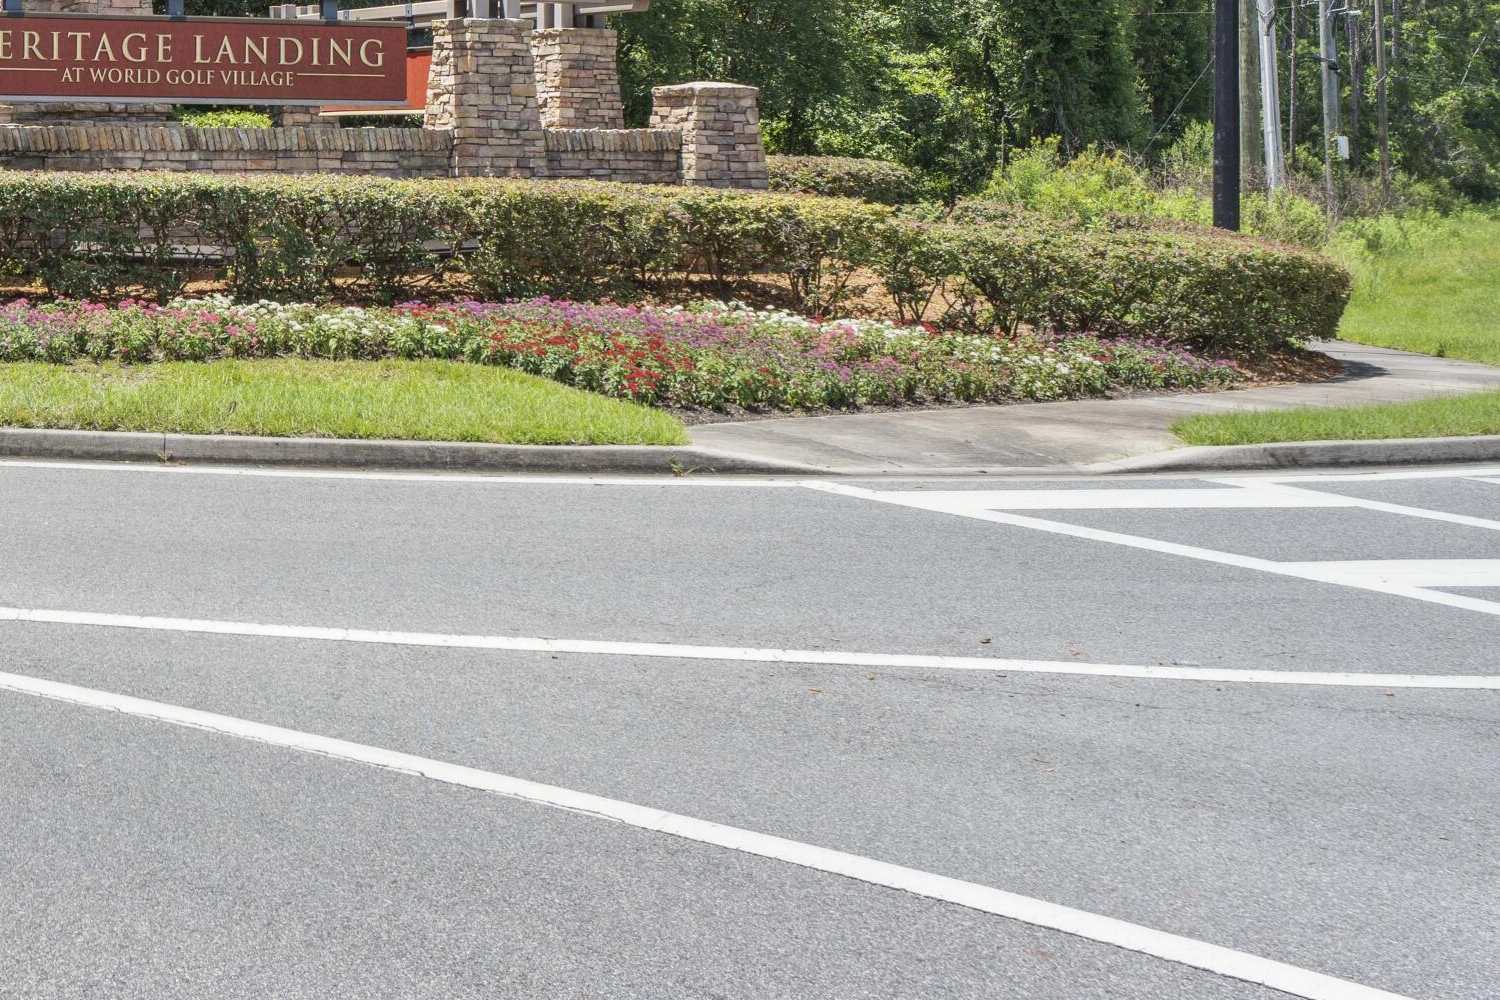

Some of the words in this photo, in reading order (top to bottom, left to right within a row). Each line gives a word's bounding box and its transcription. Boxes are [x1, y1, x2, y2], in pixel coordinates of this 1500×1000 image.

[194, 34, 386, 67] LANDING
[60, 67, 84, 83] AT
[89, 68, 161, 85] WORLD
[166, 69, 215, 86] GOLF
[220, 70, 294, 87] VILLAGE
